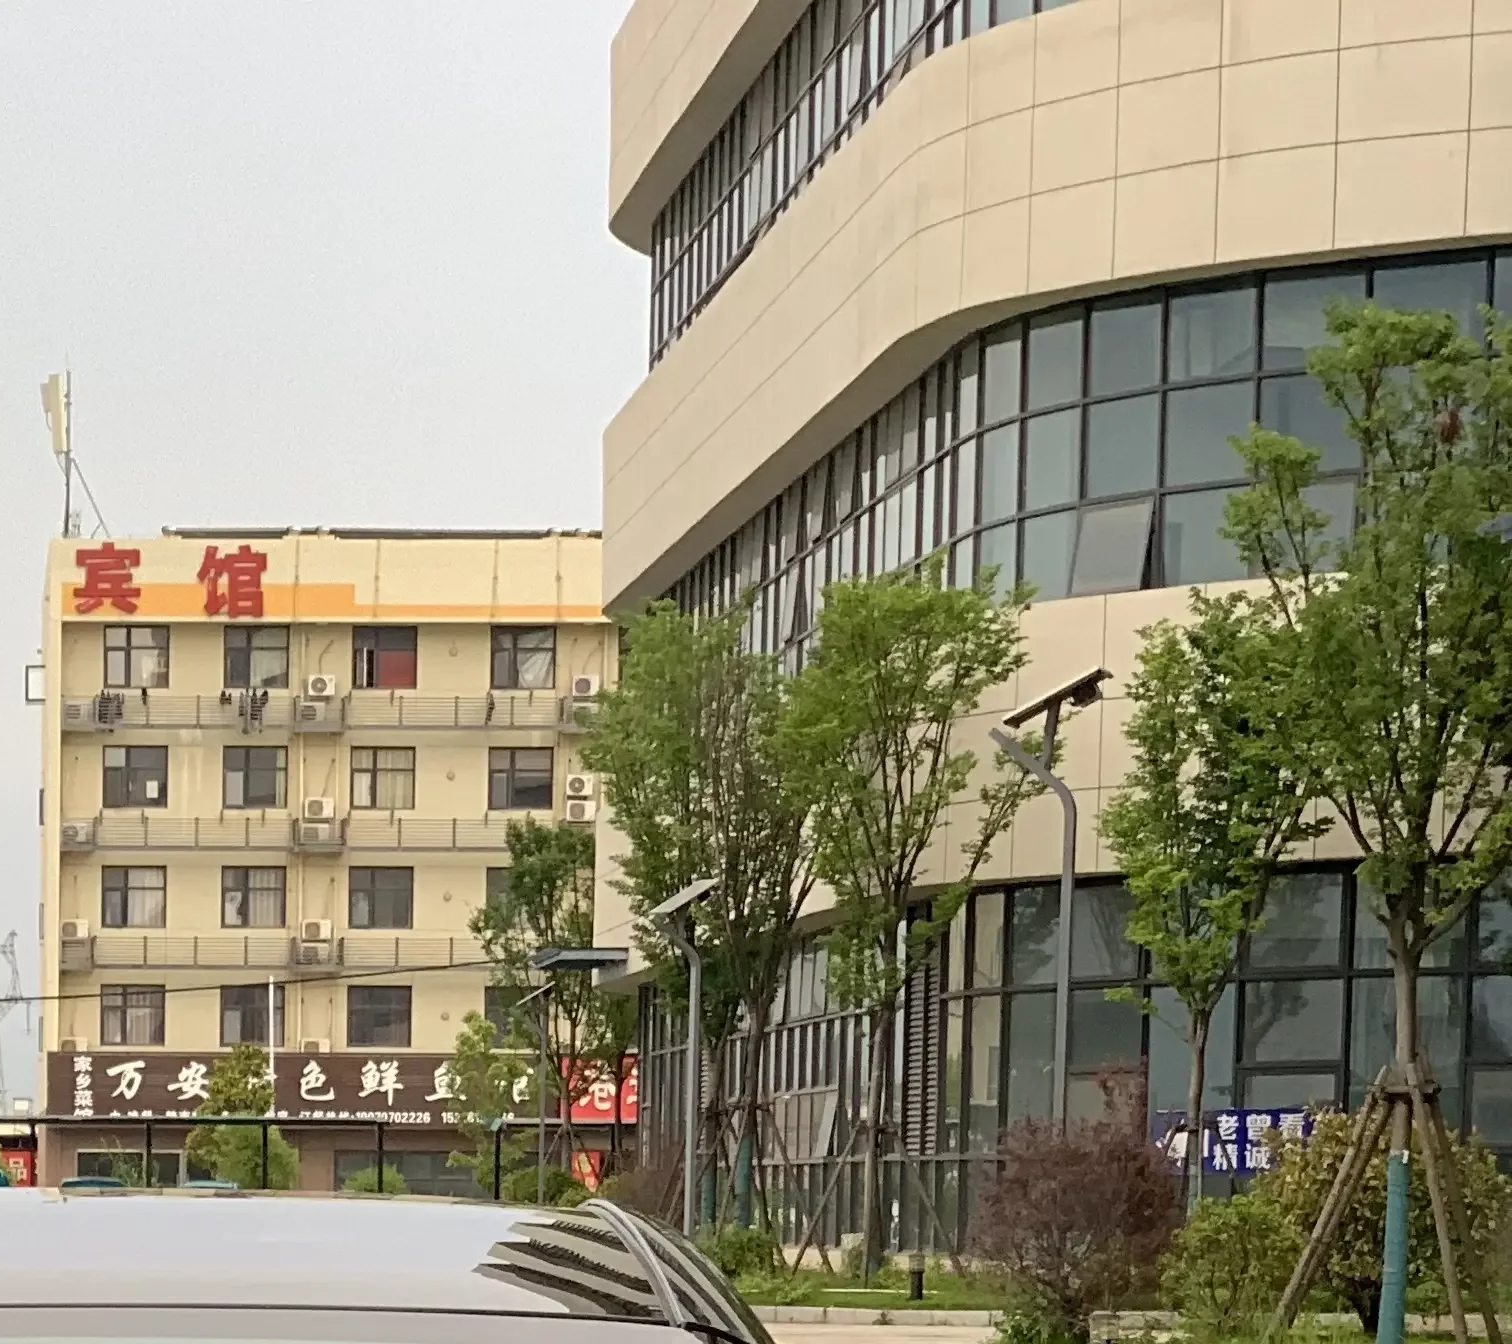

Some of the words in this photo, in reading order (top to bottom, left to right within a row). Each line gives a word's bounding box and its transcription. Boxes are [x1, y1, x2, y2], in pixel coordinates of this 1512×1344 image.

[73, 541, 268, 618] 宾馆
[105, 1059, 535, 1106] 万安色鲜鱼
